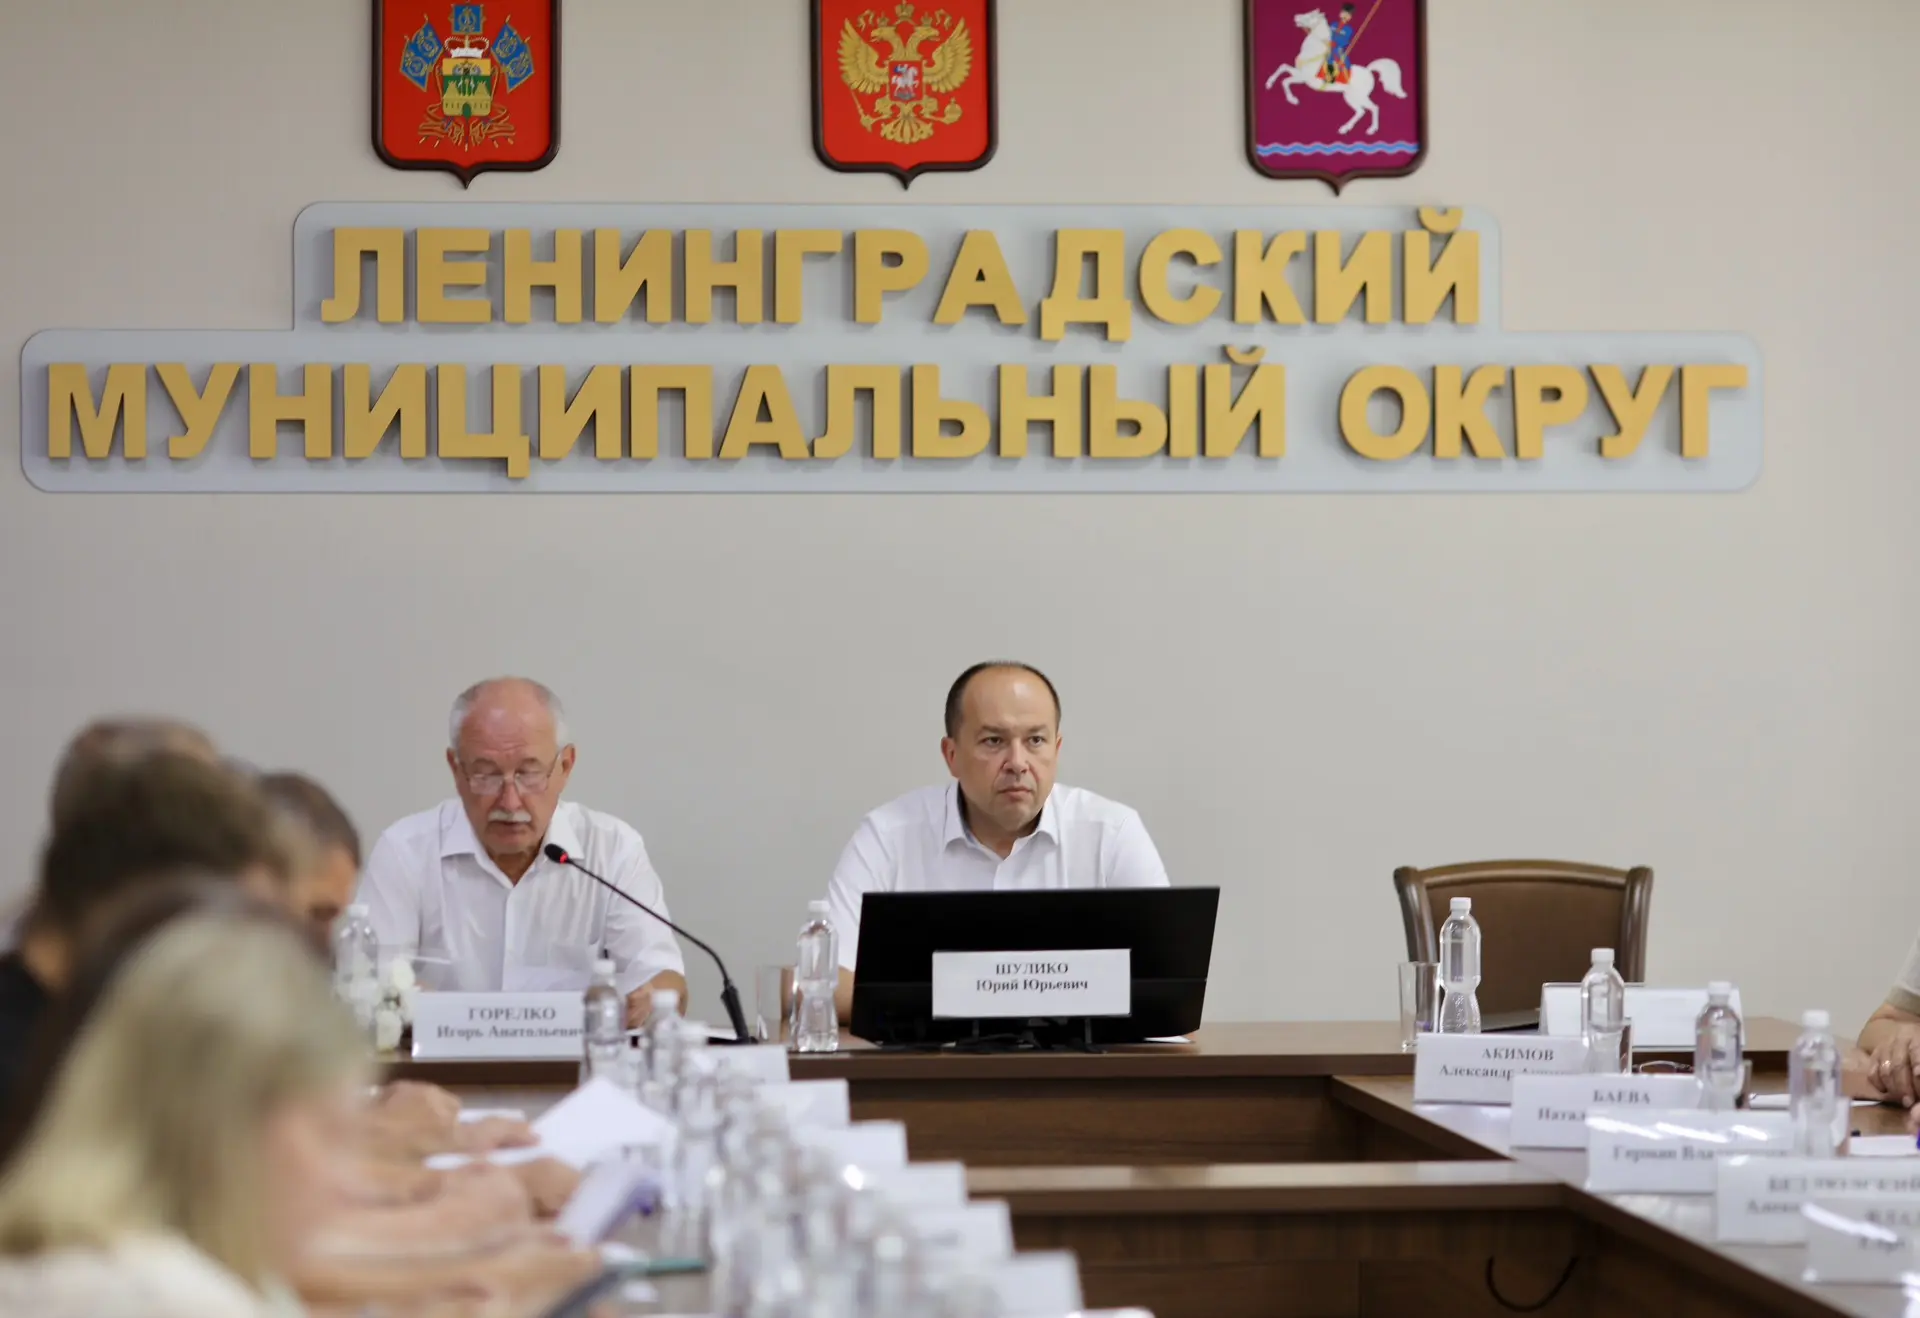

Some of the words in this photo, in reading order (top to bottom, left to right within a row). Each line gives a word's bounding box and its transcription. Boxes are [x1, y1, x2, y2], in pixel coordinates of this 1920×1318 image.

[320, 206, 1480, 342] ЛЕНИНГРАДСКИЙ
[47, 344, 1287, 478] МУНИЦИПАЛЬНЫЙ
[1337, 363, 1749, 460] ОКРУГ
[995, 962, 1069, 976] ШУЛИКО
[976, 978, 1019, 994] Юрий
[1023, 978, 1088, 994] Юрьевич
[467, 1005, 557, 1021] ГОРЕЛКО
[436, 1024, 484, 1041] Игорь
[1481, 1047, 1554, 1061] АКИМОВ
[1439, 1064, 1513, 1081] Александр
